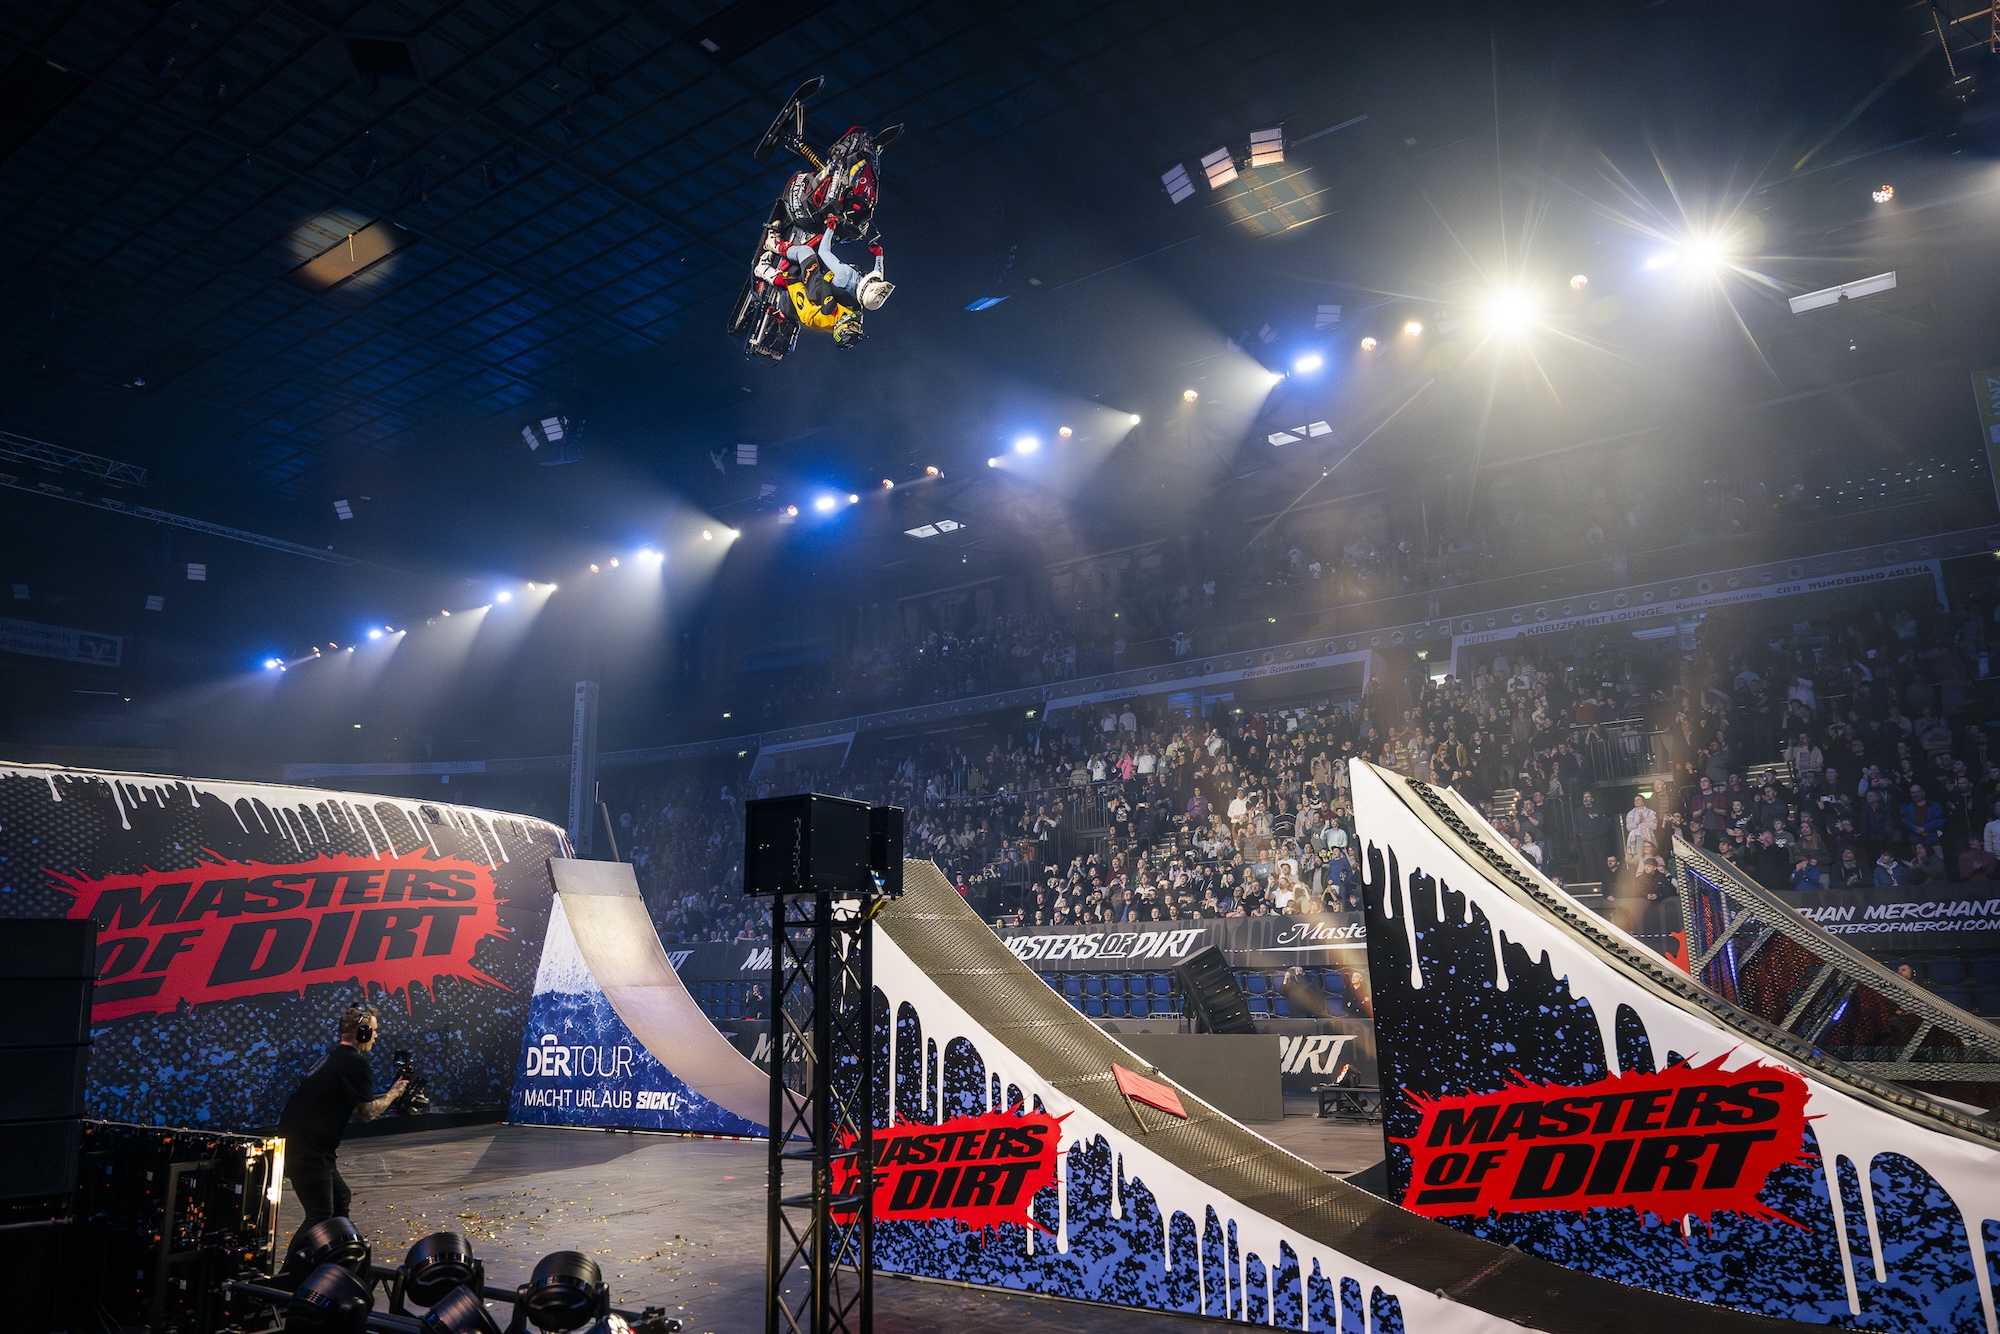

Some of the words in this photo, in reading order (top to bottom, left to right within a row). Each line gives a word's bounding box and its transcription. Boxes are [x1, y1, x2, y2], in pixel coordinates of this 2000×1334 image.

[1807, 572, 1885, 590] WUNDERINO
[1887, 565, 1933, 578] ARENA
[1610, 606, 1664, 622] LOUNGE
[1463, 632, 1500, 645] HEITEC
[88, 869, 478, 932] MASTERS
[96, 927, 205, 982] OF
[206, 907, 480, 987] DIRT
[1096, 932, 1138, 959] OF
[1127, 928, 1208, 959] DIRT
[526, 1040, 633, 1078] DERTOUR
[524, 1089, 573, 1107] MACHT
[575, 1090, 632, 1109] URLAUB
[635, 1092, 677, 1111] SICK!
[1425, 1080, 1785, 1148] MASTERS
[1423, 1149, 1507, 1186] OF
[1509, 1129, 1779, 1200] DIRT
[888, 1161, 1041, 1211] DIRT
